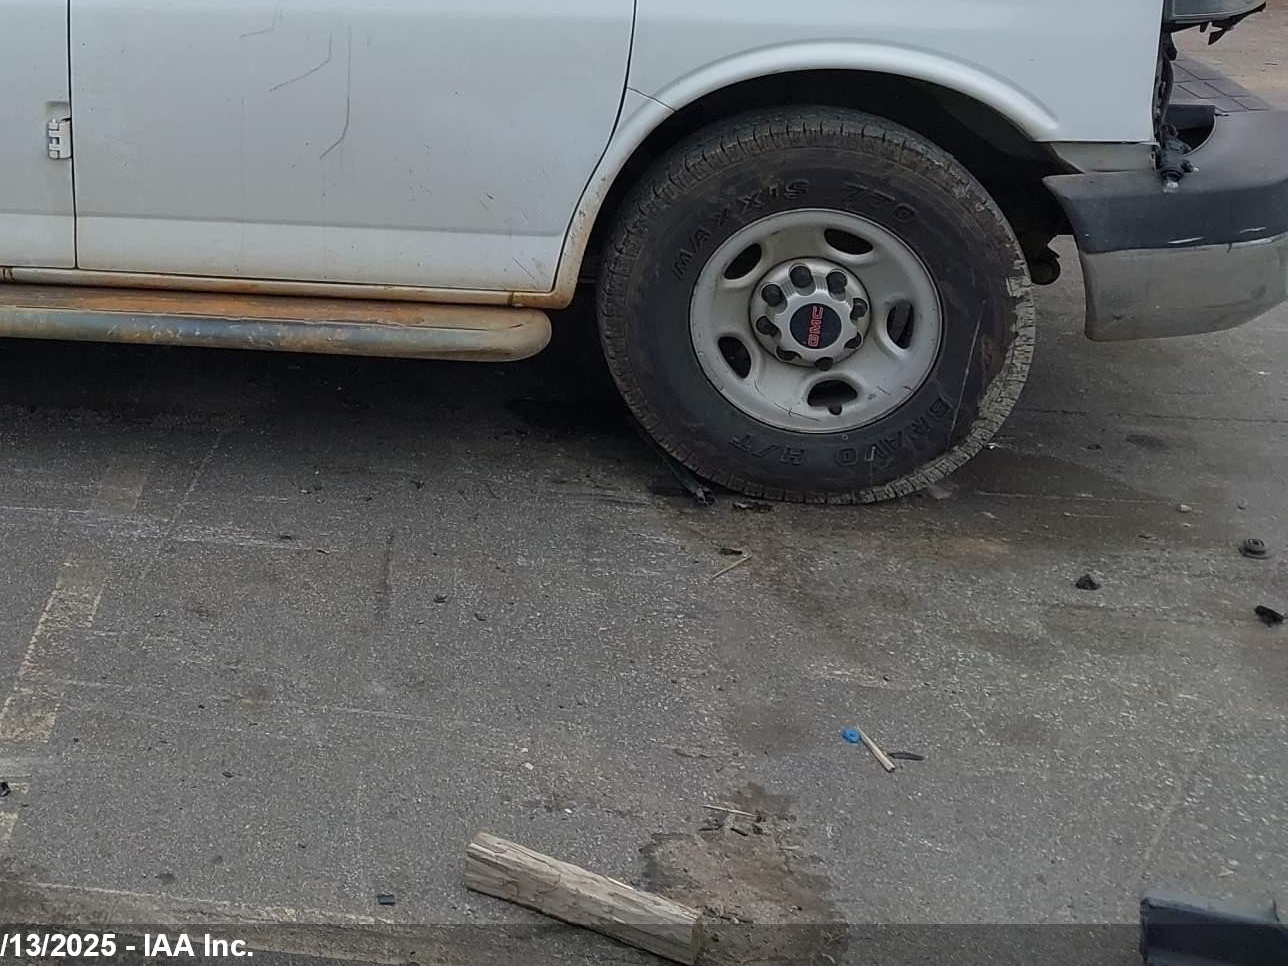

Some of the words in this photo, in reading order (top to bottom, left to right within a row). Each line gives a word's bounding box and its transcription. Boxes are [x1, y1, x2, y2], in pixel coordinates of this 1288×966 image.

[673, 177, 810, 281] MAXXIS
[842, 180, 919, 223] 770
[807, 305, 824, 347] GMC
[834, 396, 954, 467] BRAVO
